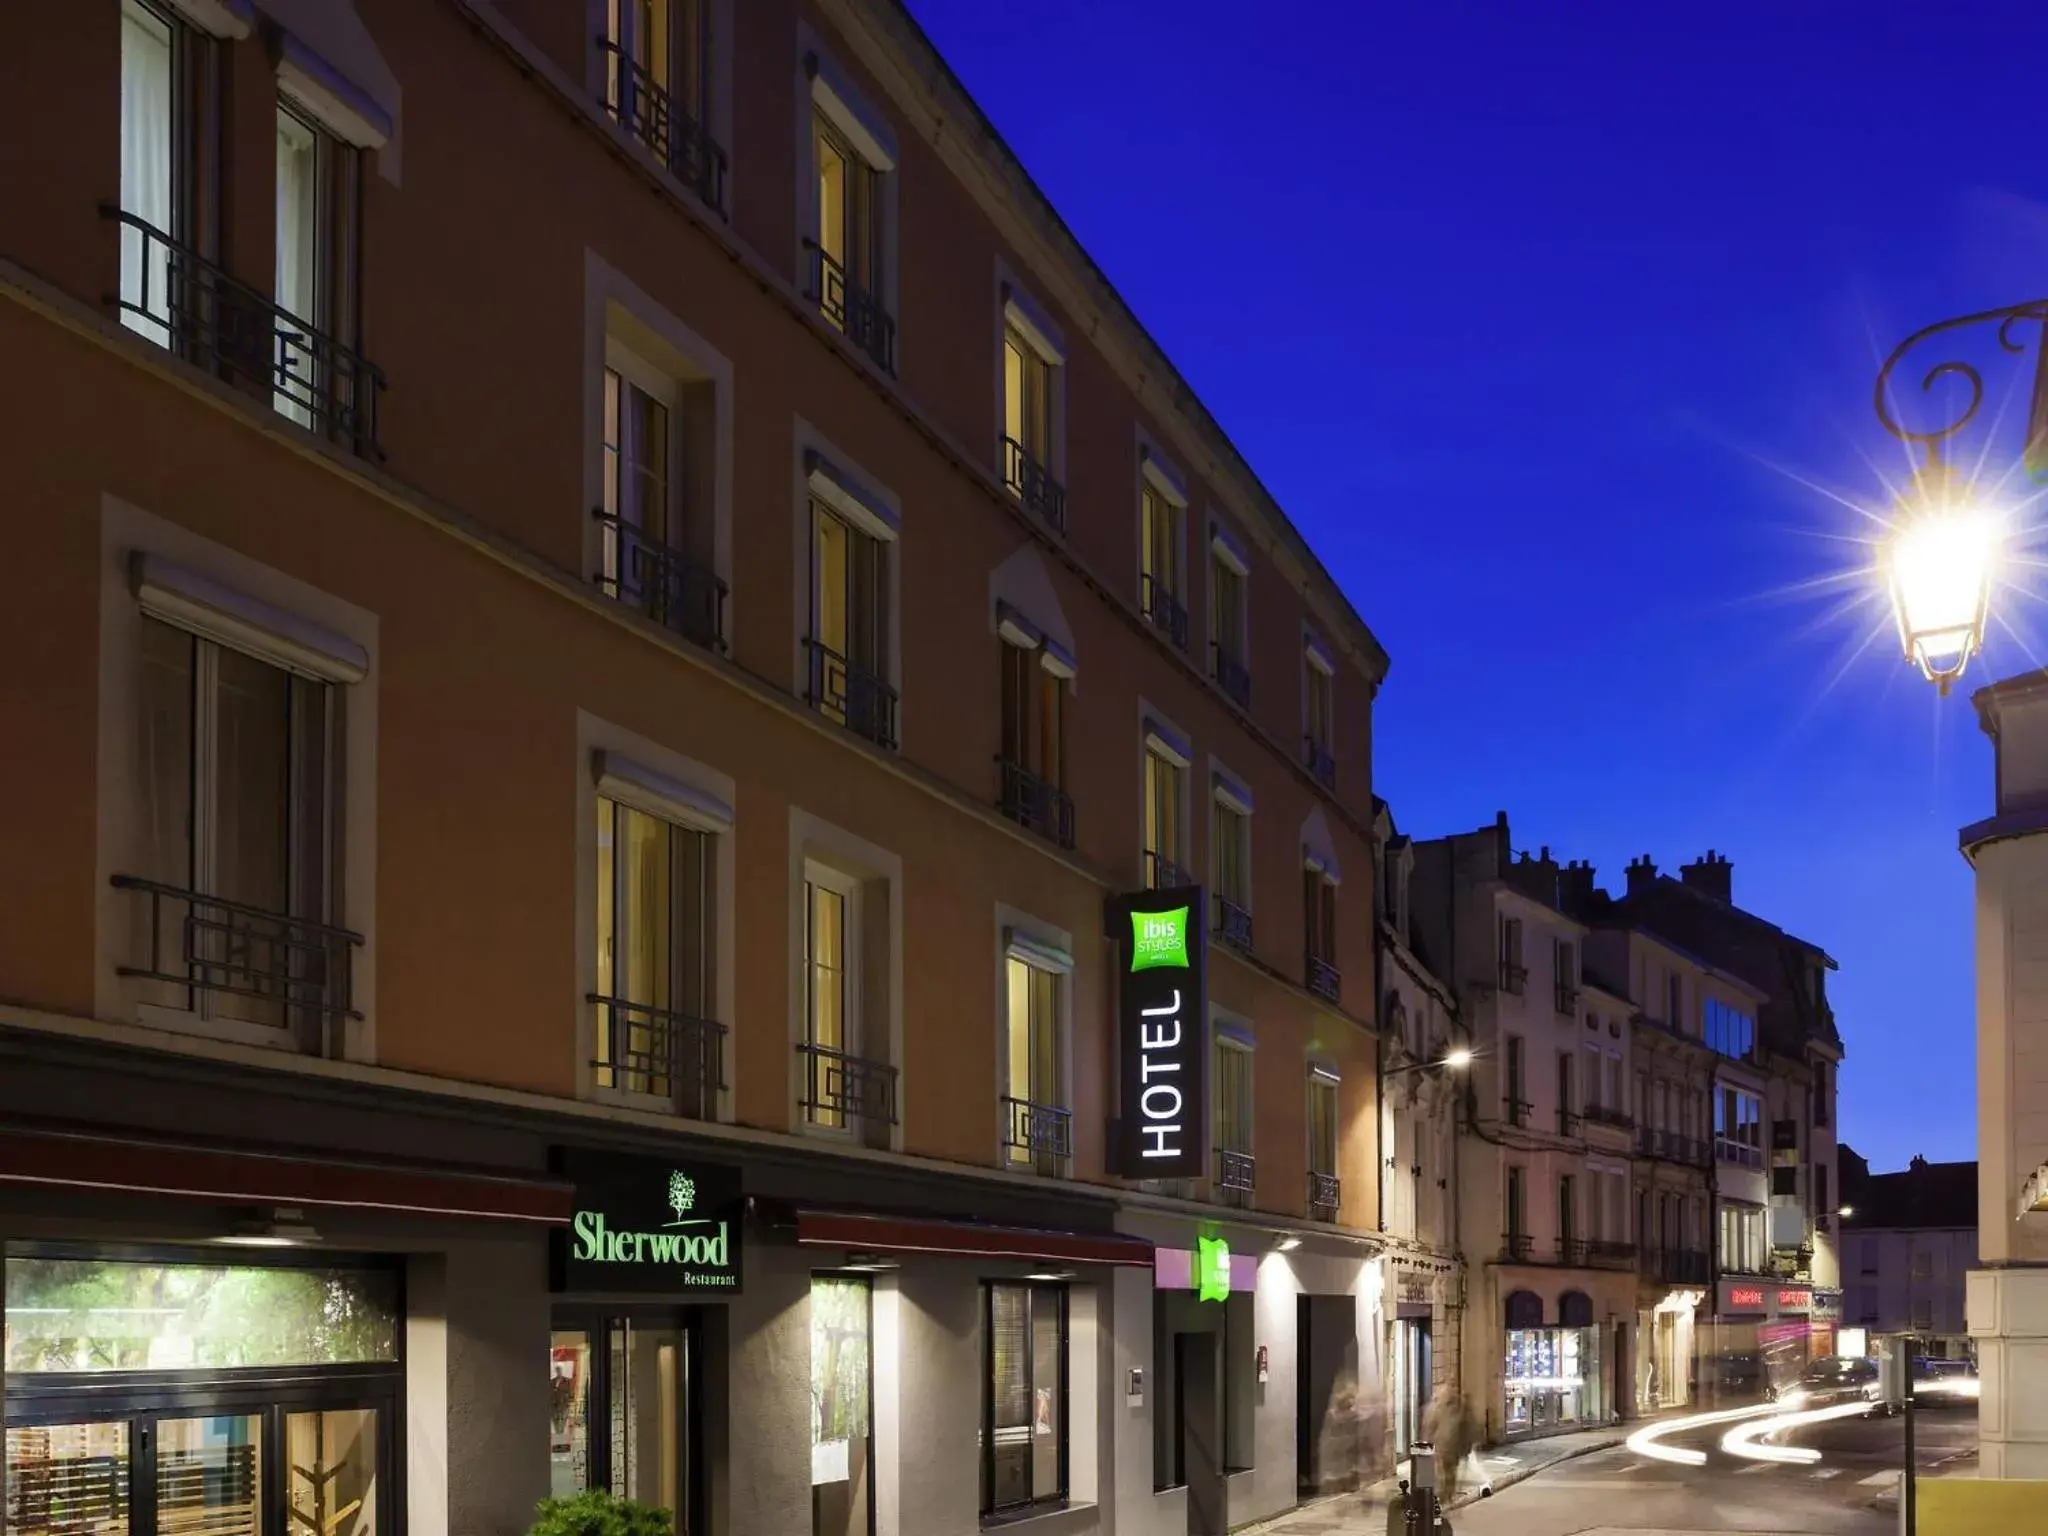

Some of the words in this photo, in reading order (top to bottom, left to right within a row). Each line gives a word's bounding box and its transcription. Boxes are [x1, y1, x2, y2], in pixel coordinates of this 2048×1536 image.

[1143, 919, 1176, 938] ibis
[1141, 990, 1182, 1158] HOTEL
[573, 1210, 728, 1266] Sherwood
[683, 1271, 736, 1286] Restaurant
